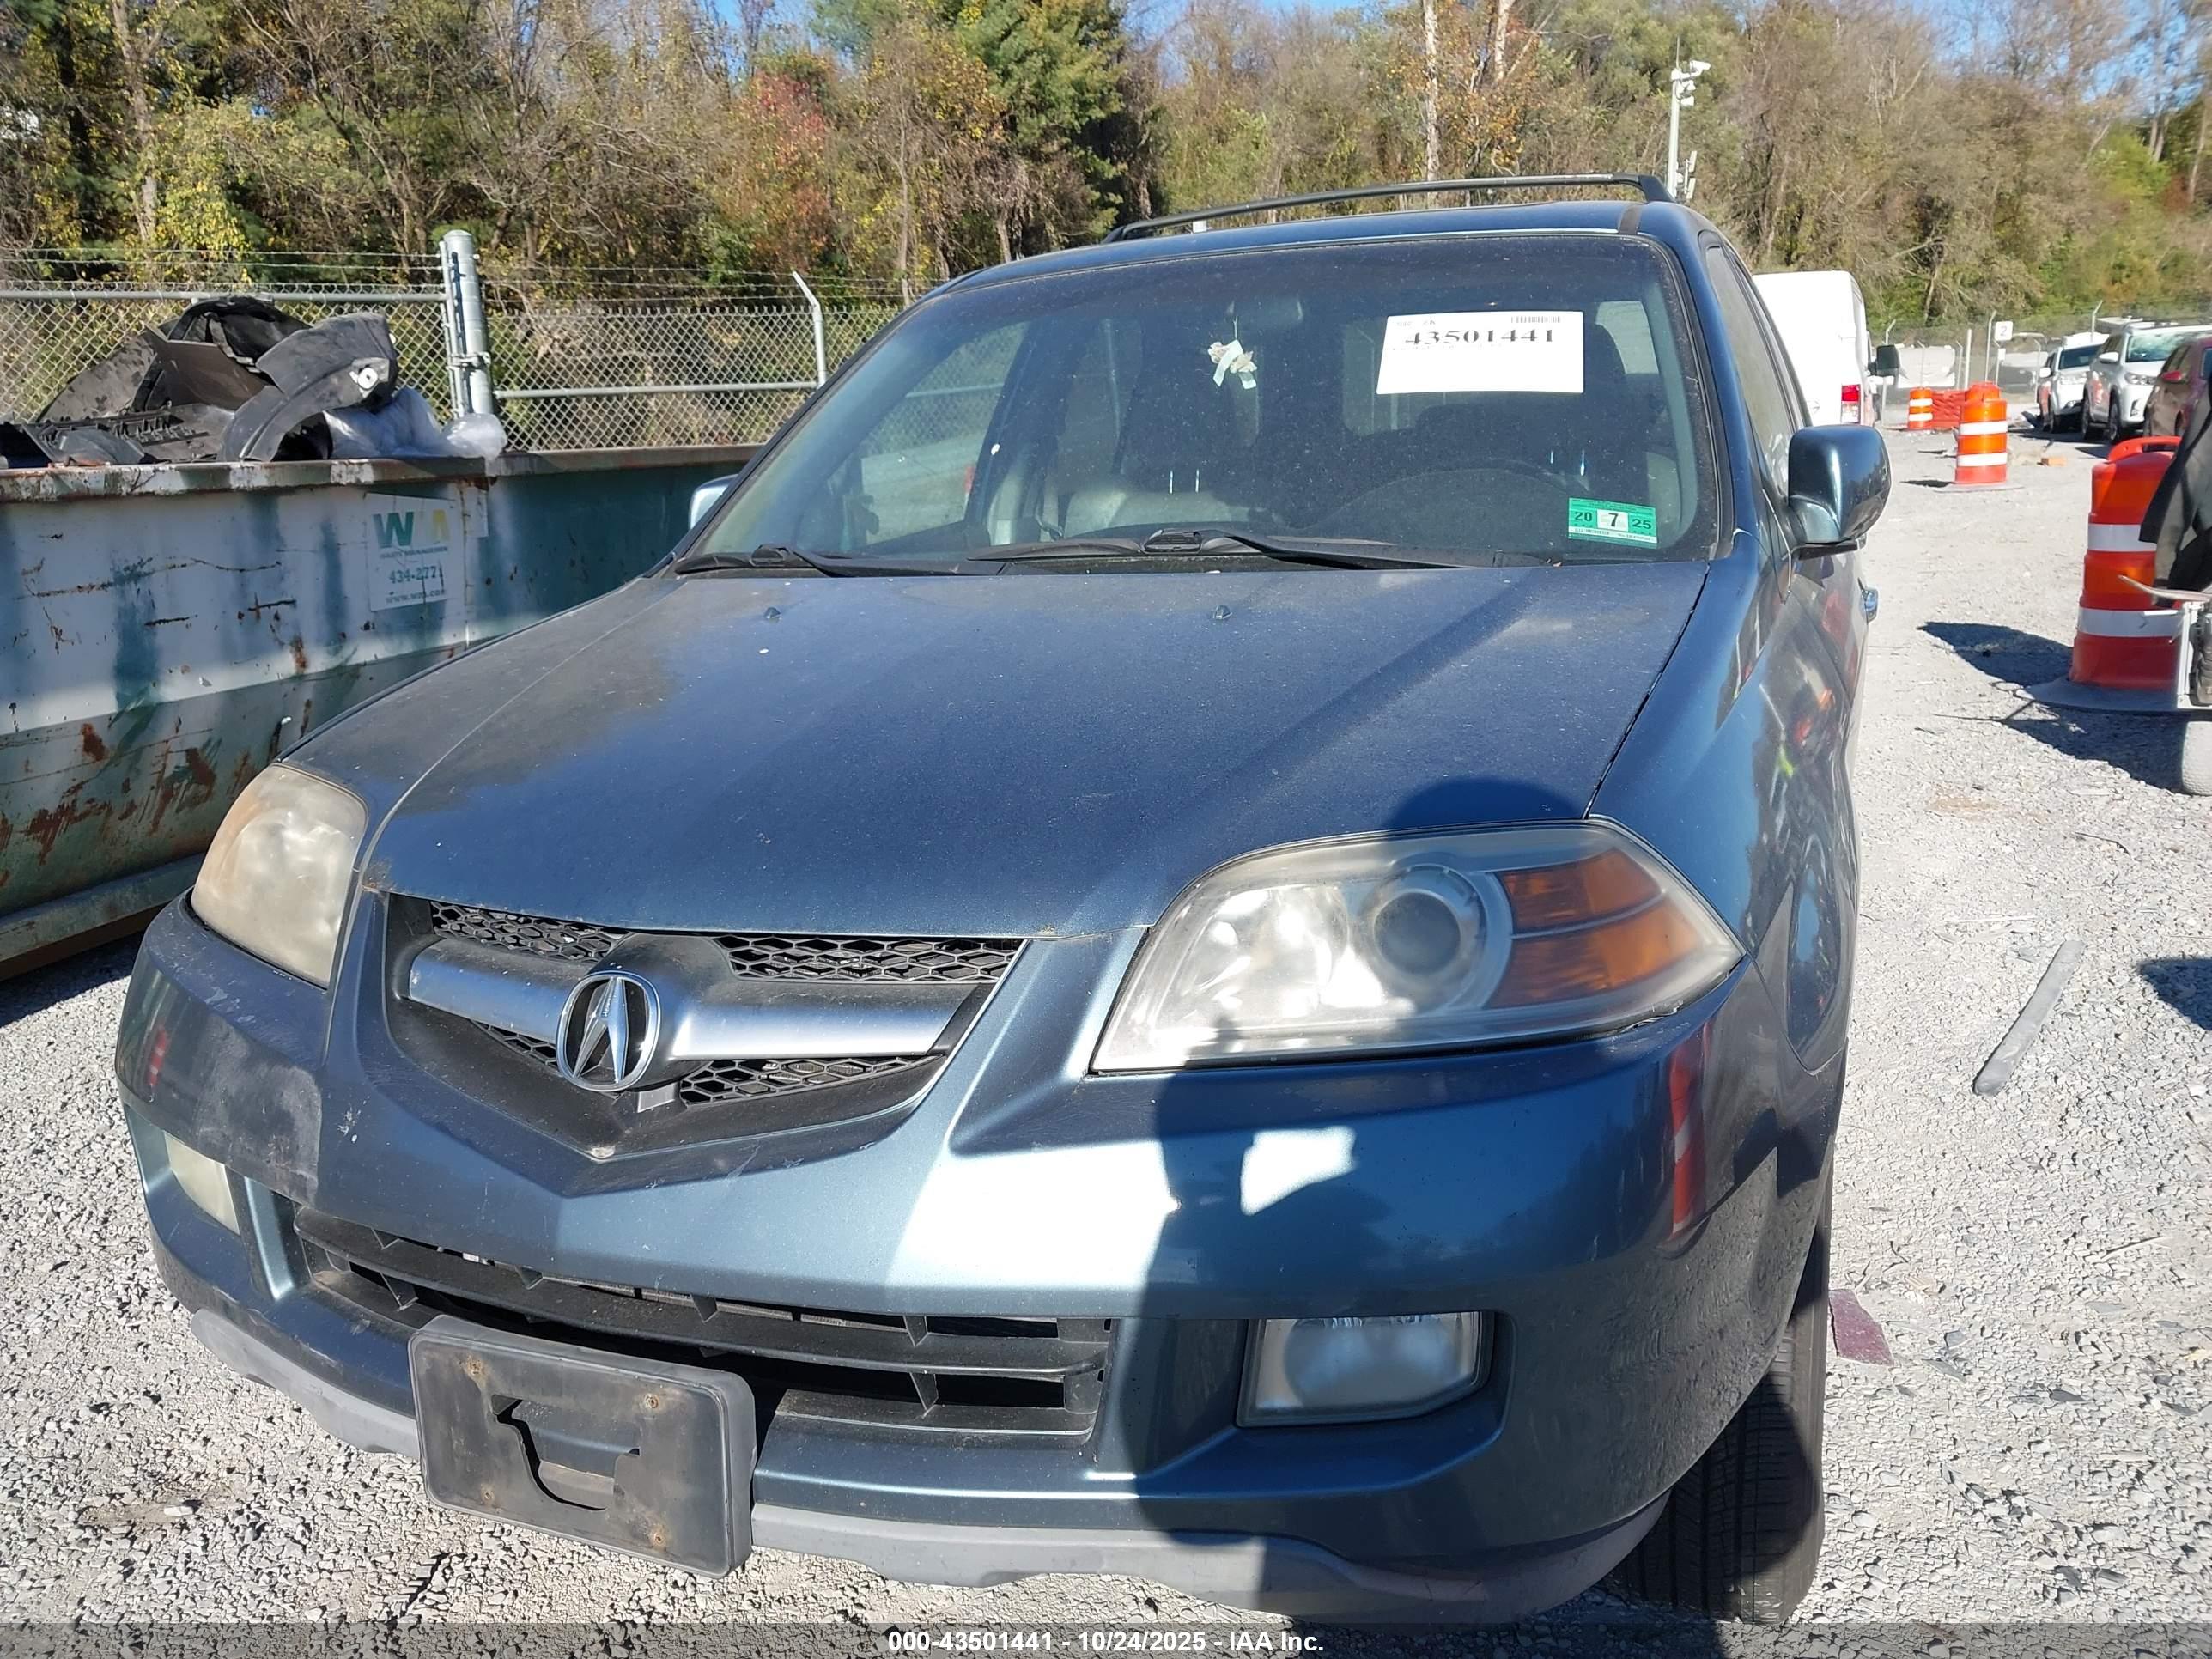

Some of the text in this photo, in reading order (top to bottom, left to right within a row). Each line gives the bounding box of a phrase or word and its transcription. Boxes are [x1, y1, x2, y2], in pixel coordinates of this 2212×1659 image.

[1405, 329, 1553, 344] 43501441
[2000, 325, 2008, 336] 2
[1574, 511, 1651, 530] 20 7 25
